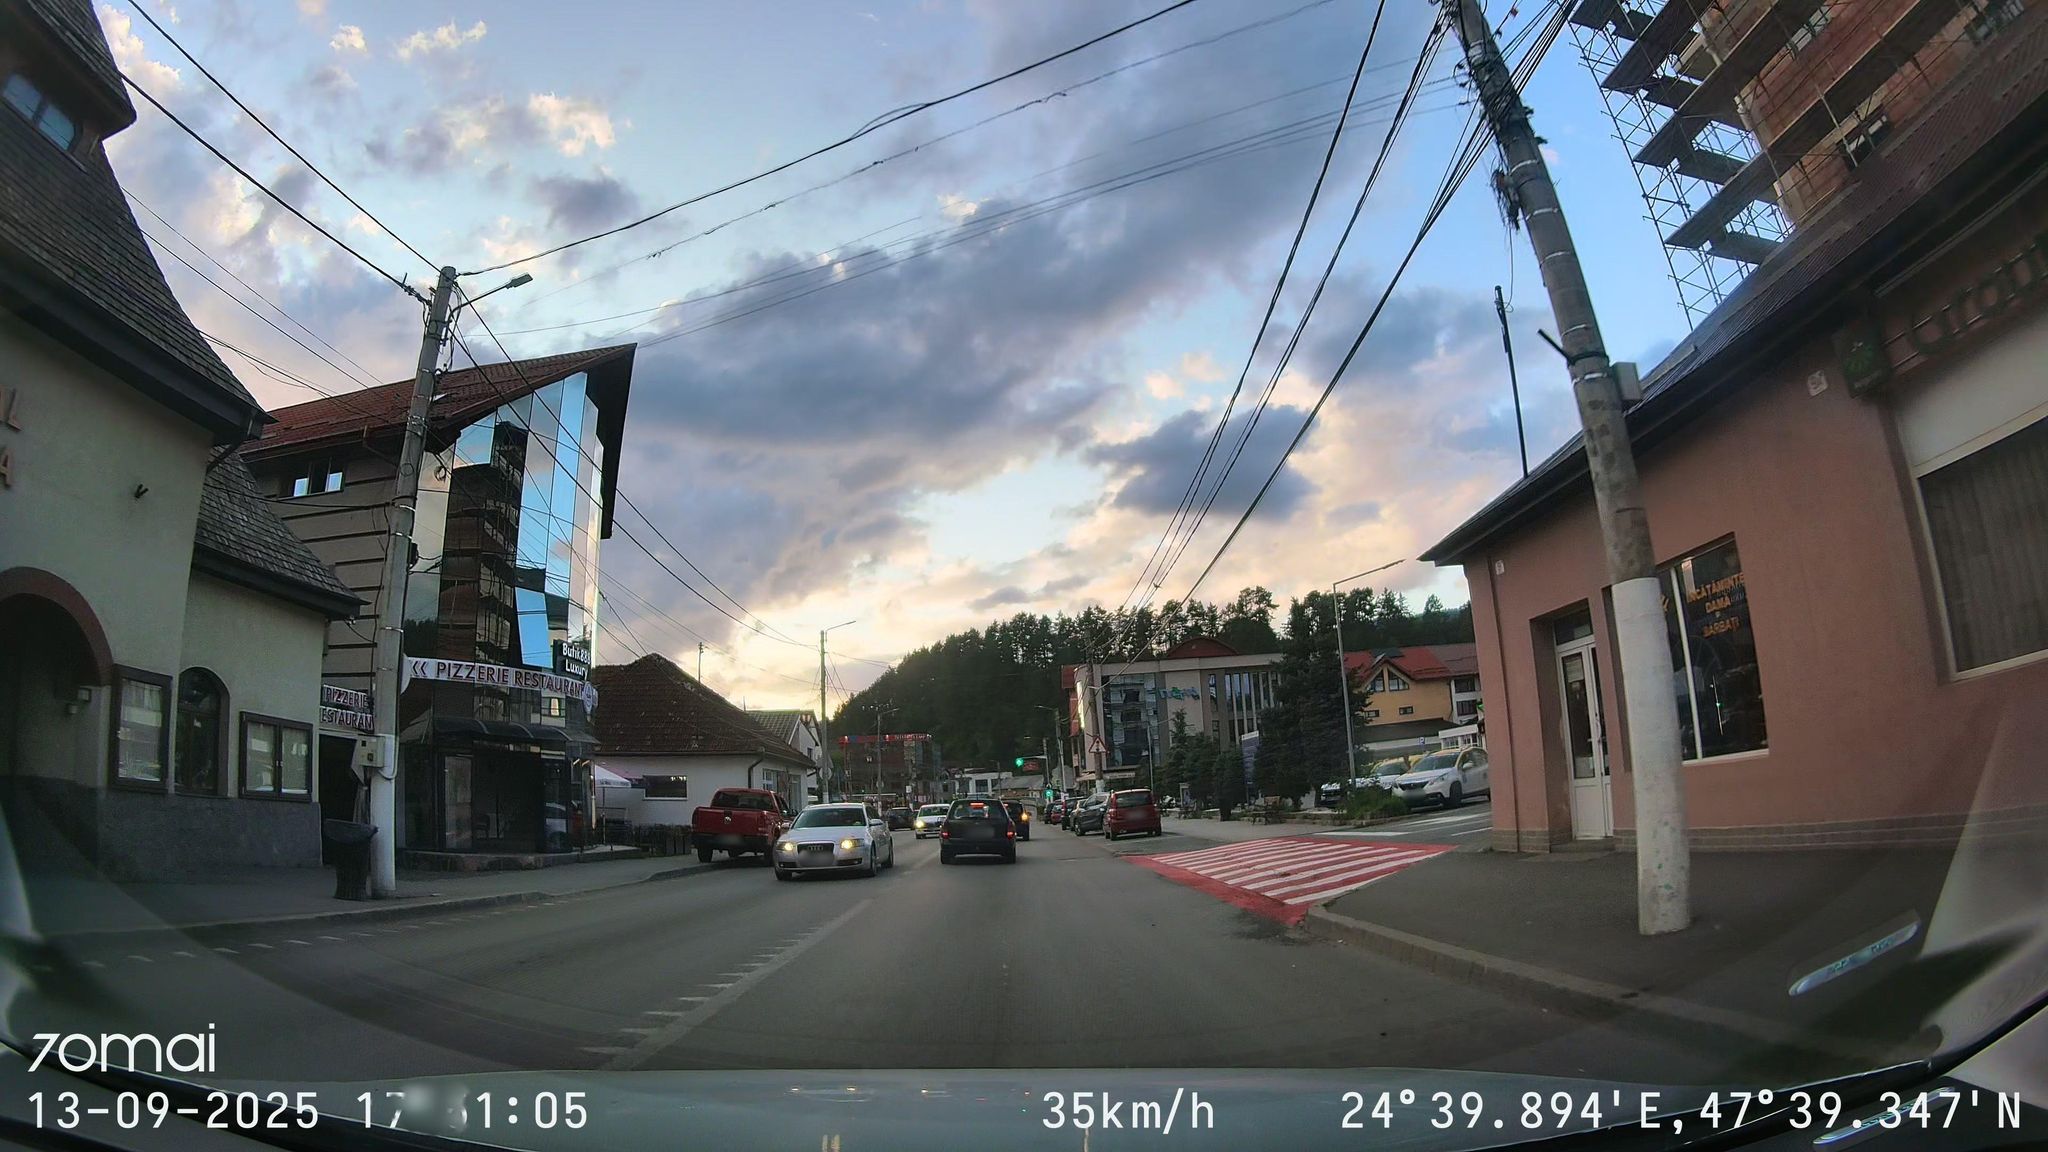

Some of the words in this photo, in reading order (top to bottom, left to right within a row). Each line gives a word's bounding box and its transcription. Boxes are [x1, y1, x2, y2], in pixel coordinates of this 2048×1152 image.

[436, 661, 509, 684] PIZZERIE
[513, 669, 585, 698] RESTAURANT
[565, 658, 589, 681] Luxury
[324, 687, 370, 709] PIZZERIE
